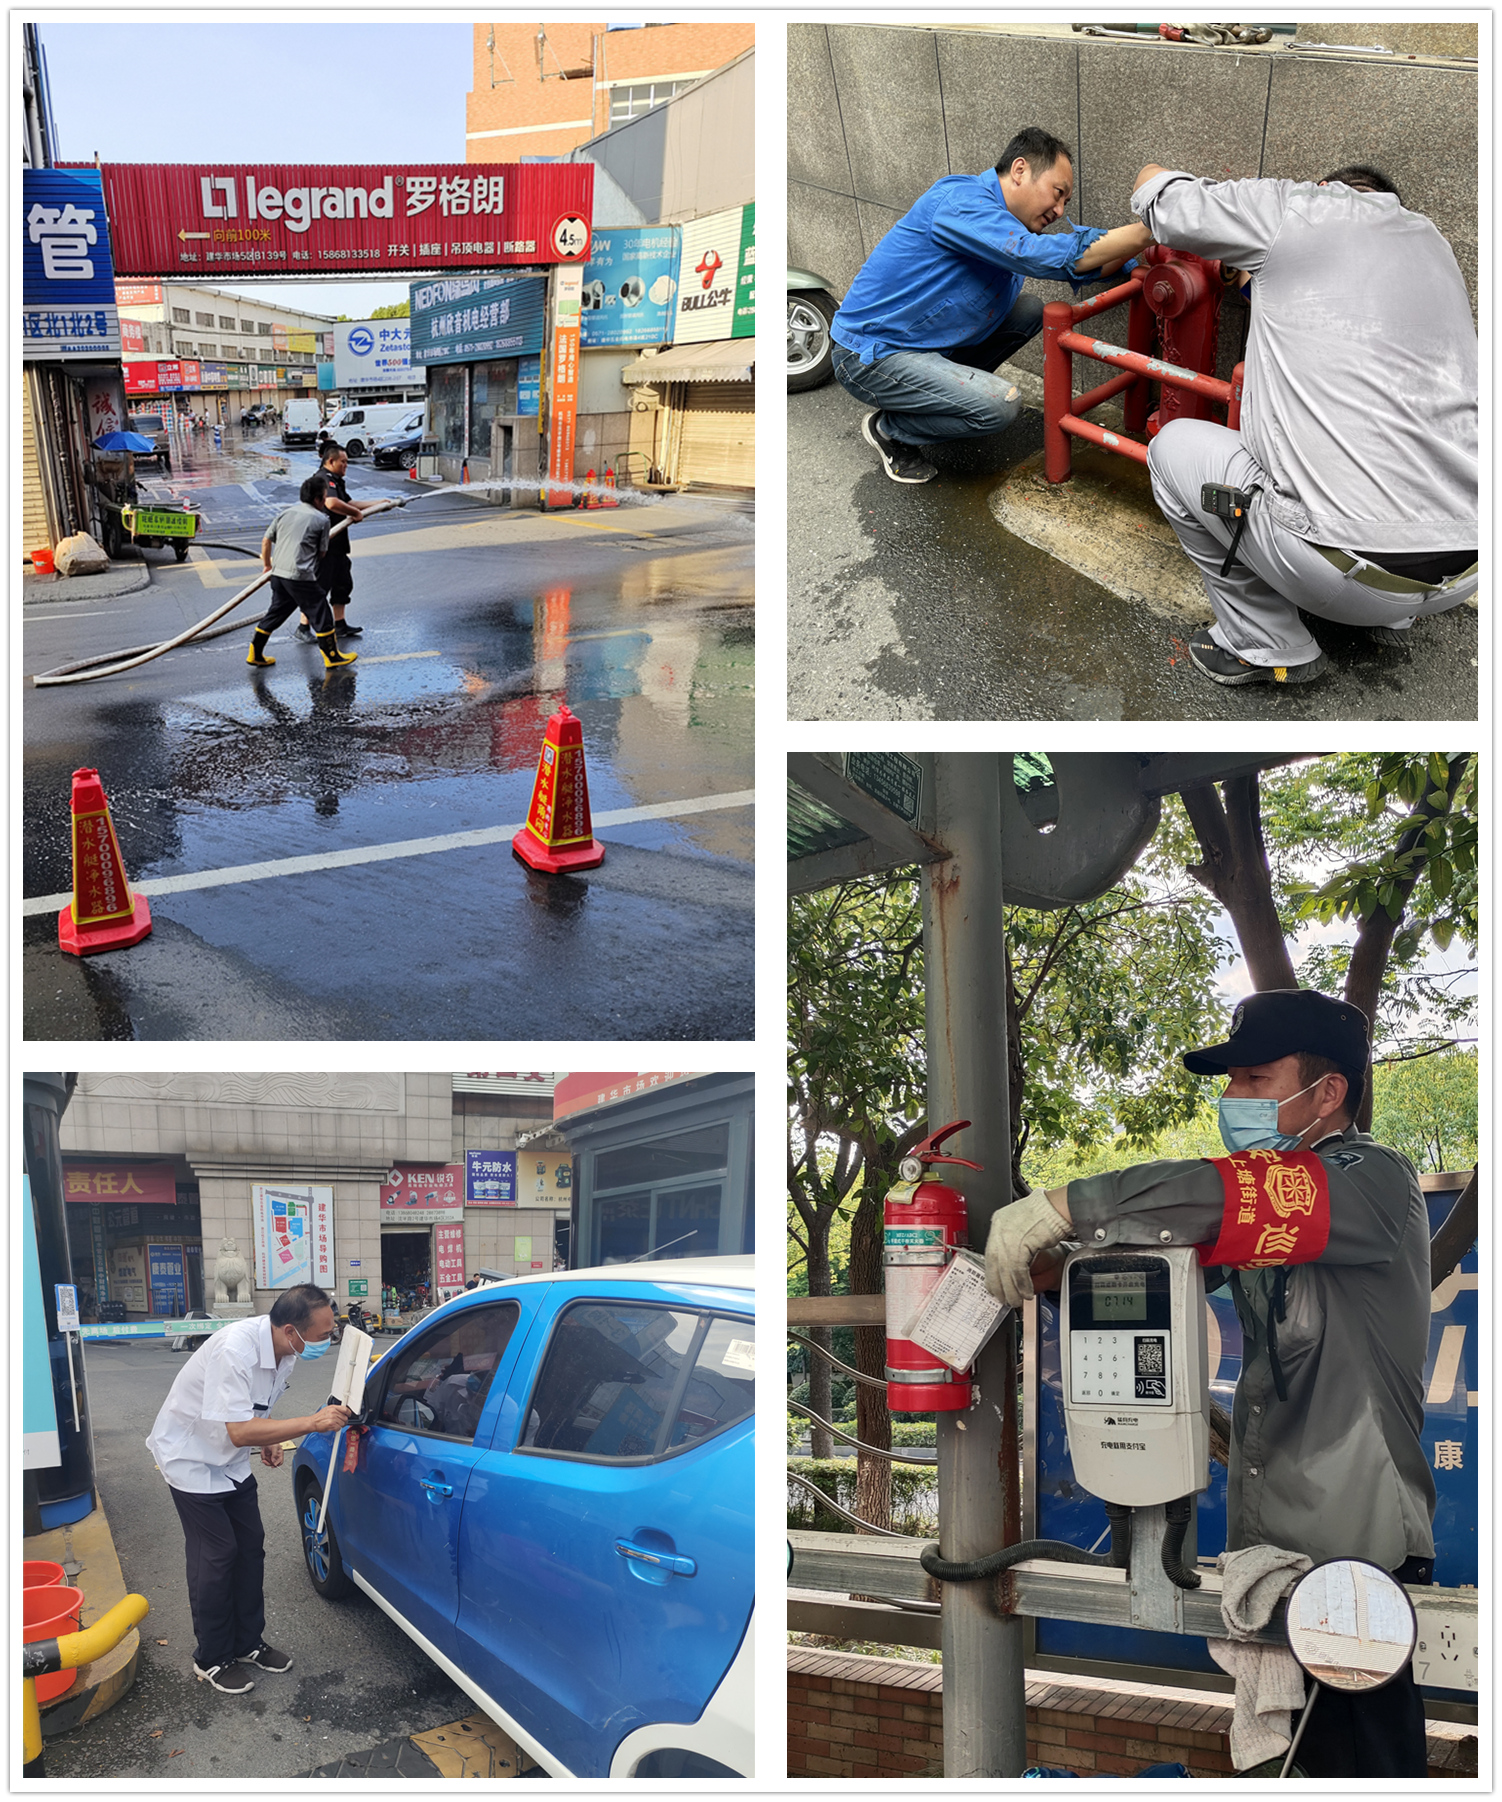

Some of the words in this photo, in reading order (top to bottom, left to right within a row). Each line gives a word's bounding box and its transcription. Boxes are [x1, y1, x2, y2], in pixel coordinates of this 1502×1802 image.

[246, 176, 394, 233] legrand
[405, 176, 504, 217] 罗格朗
[27, 203, 97, 279] 管
[213, 229, 272, 243] 向前100米
[387, 244, 410, 257] 开关
[419, 243, 442, 257] 插座
[450, 241, 495, 255] 吊顶电器
[503, 240, 537, 254] 断路器
[79, 820, 105, 915] 潜水艇净水器
[472, 1161, 512, 1173] 牛元防水
[67, 1171, 144, 1195] 责任人
[407, 1173, 434, 1183] KEN
[1228, 1157, 1258, 1225] 上塘街道
[317, 1203, 332, 1274] 建华市场导购图
[439, 1258, 462, 1269] 电动工具
[439, 1273, 463, 1283] 五金工具
[1082, 1354, 1089, 1362] 4
[1111, 1354, 1118, 1362] 6
[1082, 1371, 1089, 1379] 7
[1097, 1371, 1104, 1379] 8
[1097, 1388, 1103, 1397] 0
[1433, 1439, 1464, 1471] 康
[1418, 1661, 1430, 1680] 7
